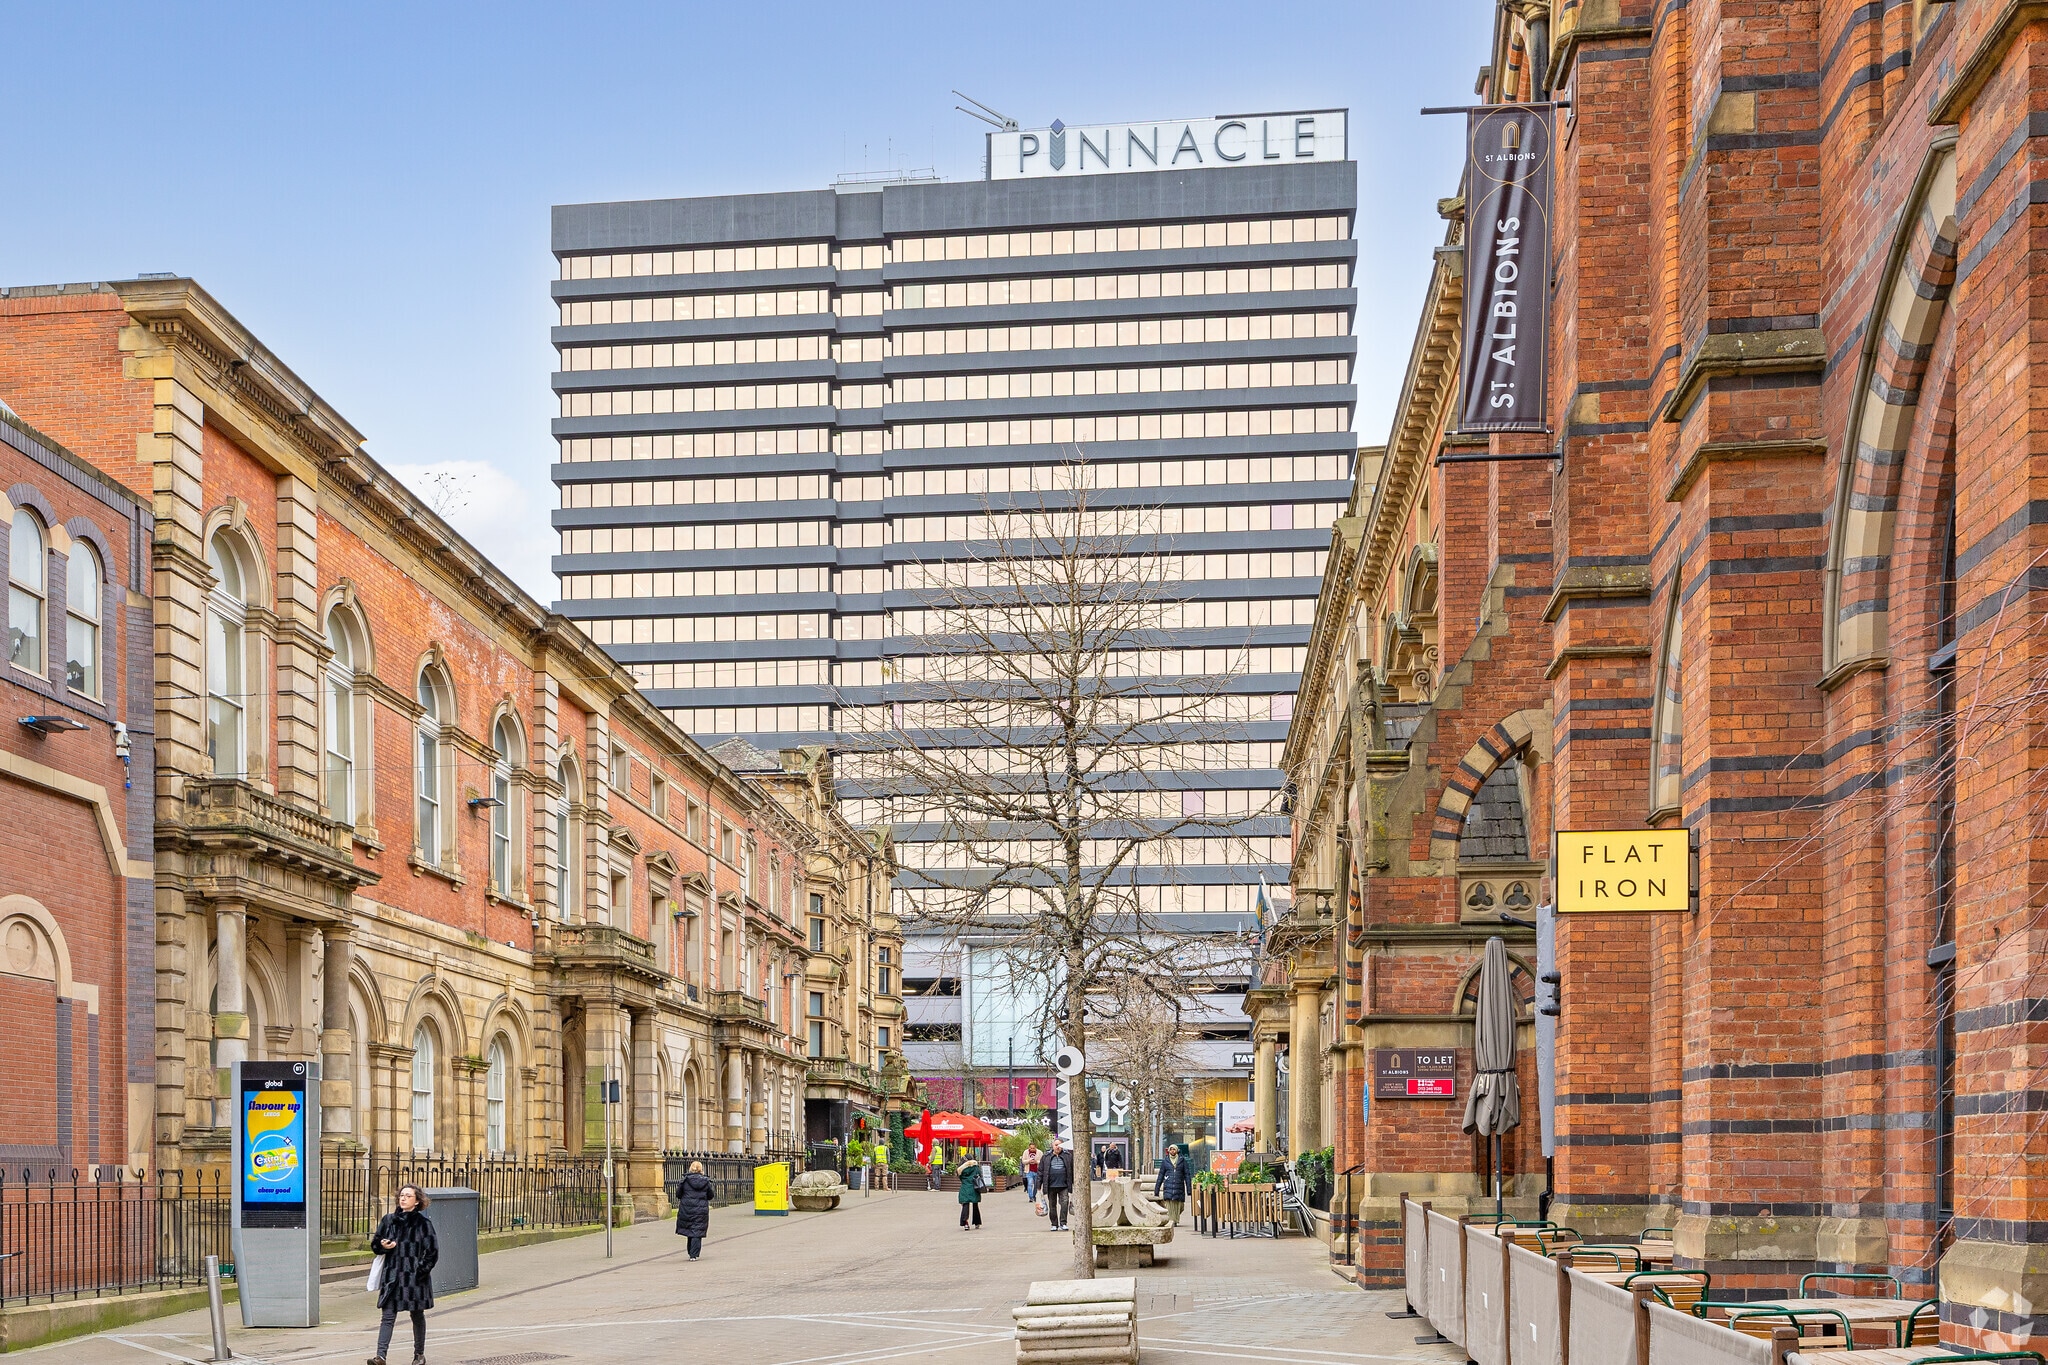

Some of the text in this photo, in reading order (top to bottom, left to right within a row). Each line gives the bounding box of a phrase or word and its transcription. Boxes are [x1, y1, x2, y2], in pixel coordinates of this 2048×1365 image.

[1019, 117, 1315, 173] PINNACLE
[1496, 152, 1536, 162] ALBIONS
[1492, 216, 1520, 366] ALBIONS
[1583, 844, 1664, 864] FLAT
[1580, 878, 1666, 898] IRON
[1417, 1056, 1453, 1064] TO LET
[264, 1080, 283, 1089] global
[248, 1100, 301, 1113] flavour up
[275, 1187, 291, 1195] good
